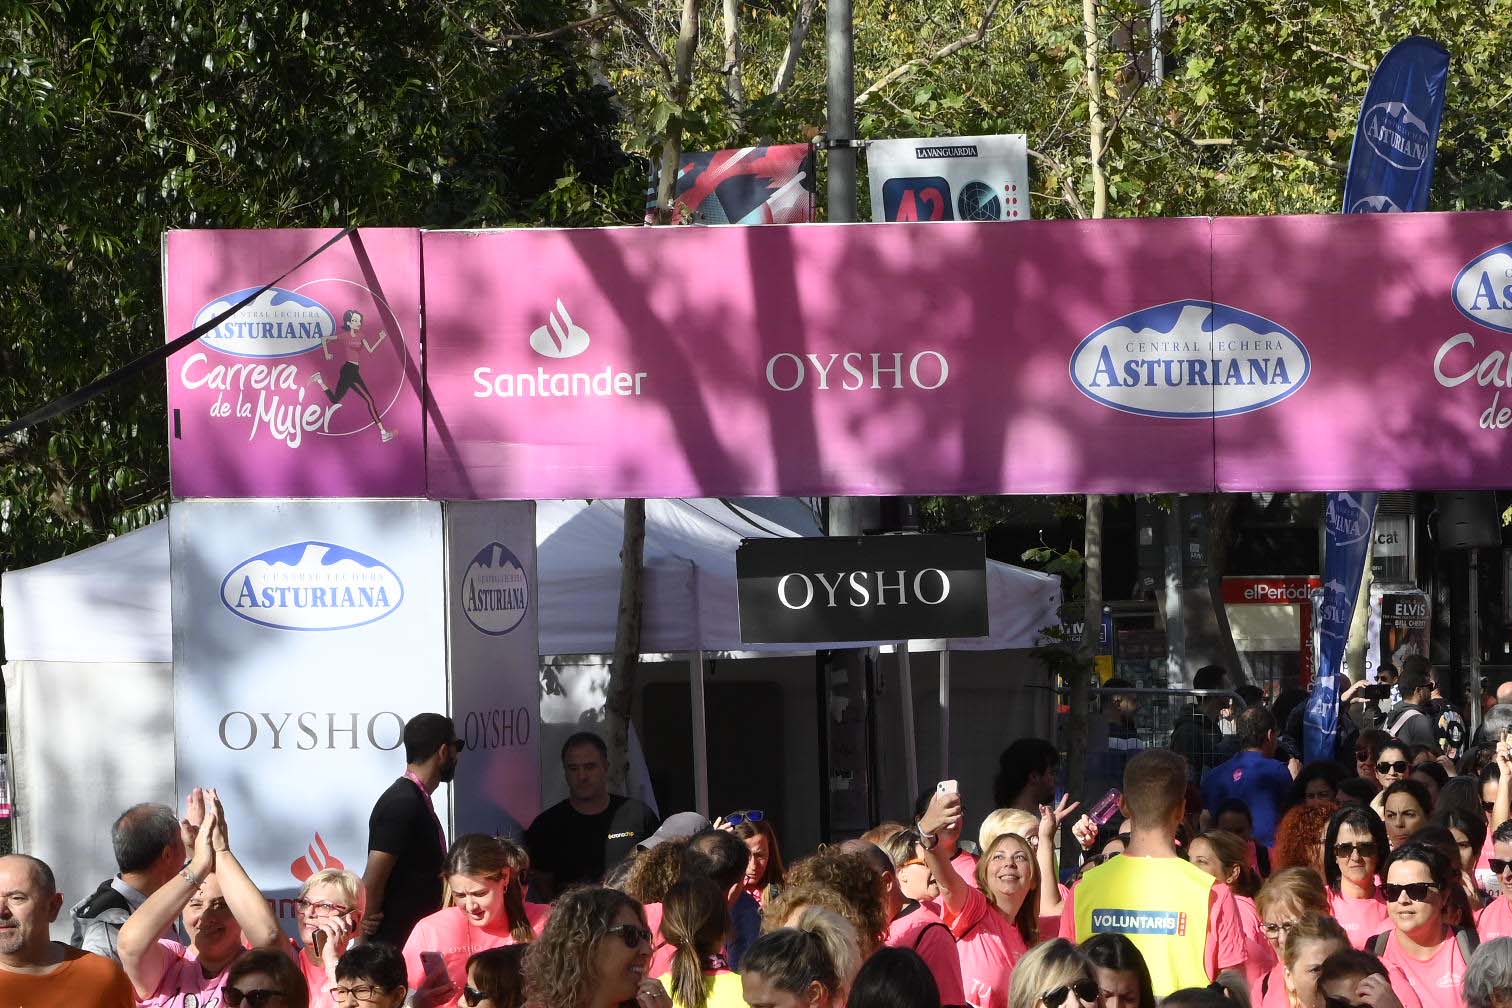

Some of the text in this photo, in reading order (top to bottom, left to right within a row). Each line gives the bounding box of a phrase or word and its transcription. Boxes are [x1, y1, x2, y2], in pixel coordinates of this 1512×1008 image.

[204, 313, 324, 340] ASTURIANA
[1125, 341, 1200, 353] CENTRAL
[181, 353, 298, 391] Carrera
[473, 366, 647, 399] Santander
[766, 350, 949, 392] OYSHO
[1089, 345, 1292, 389] ASTURIANA
[209, 387, 342, 449] de la Mujer
[1479, 392, 1512, 430] de
[235, 575, 391, 609] ASTURIANA
[467, 576, 525, 613] ASTURIANA
[777, 568, 951, 610] OYSHO
[1245, 584, 1321, 602] elPeriódi
[1395, 603, 1426, 616] ELVIS
[218, 710, 407, 752] OYSHO
[464, 706, 531, 752] OYSHO
[1093, 914, 1177, 932] VOLUNTARIS
